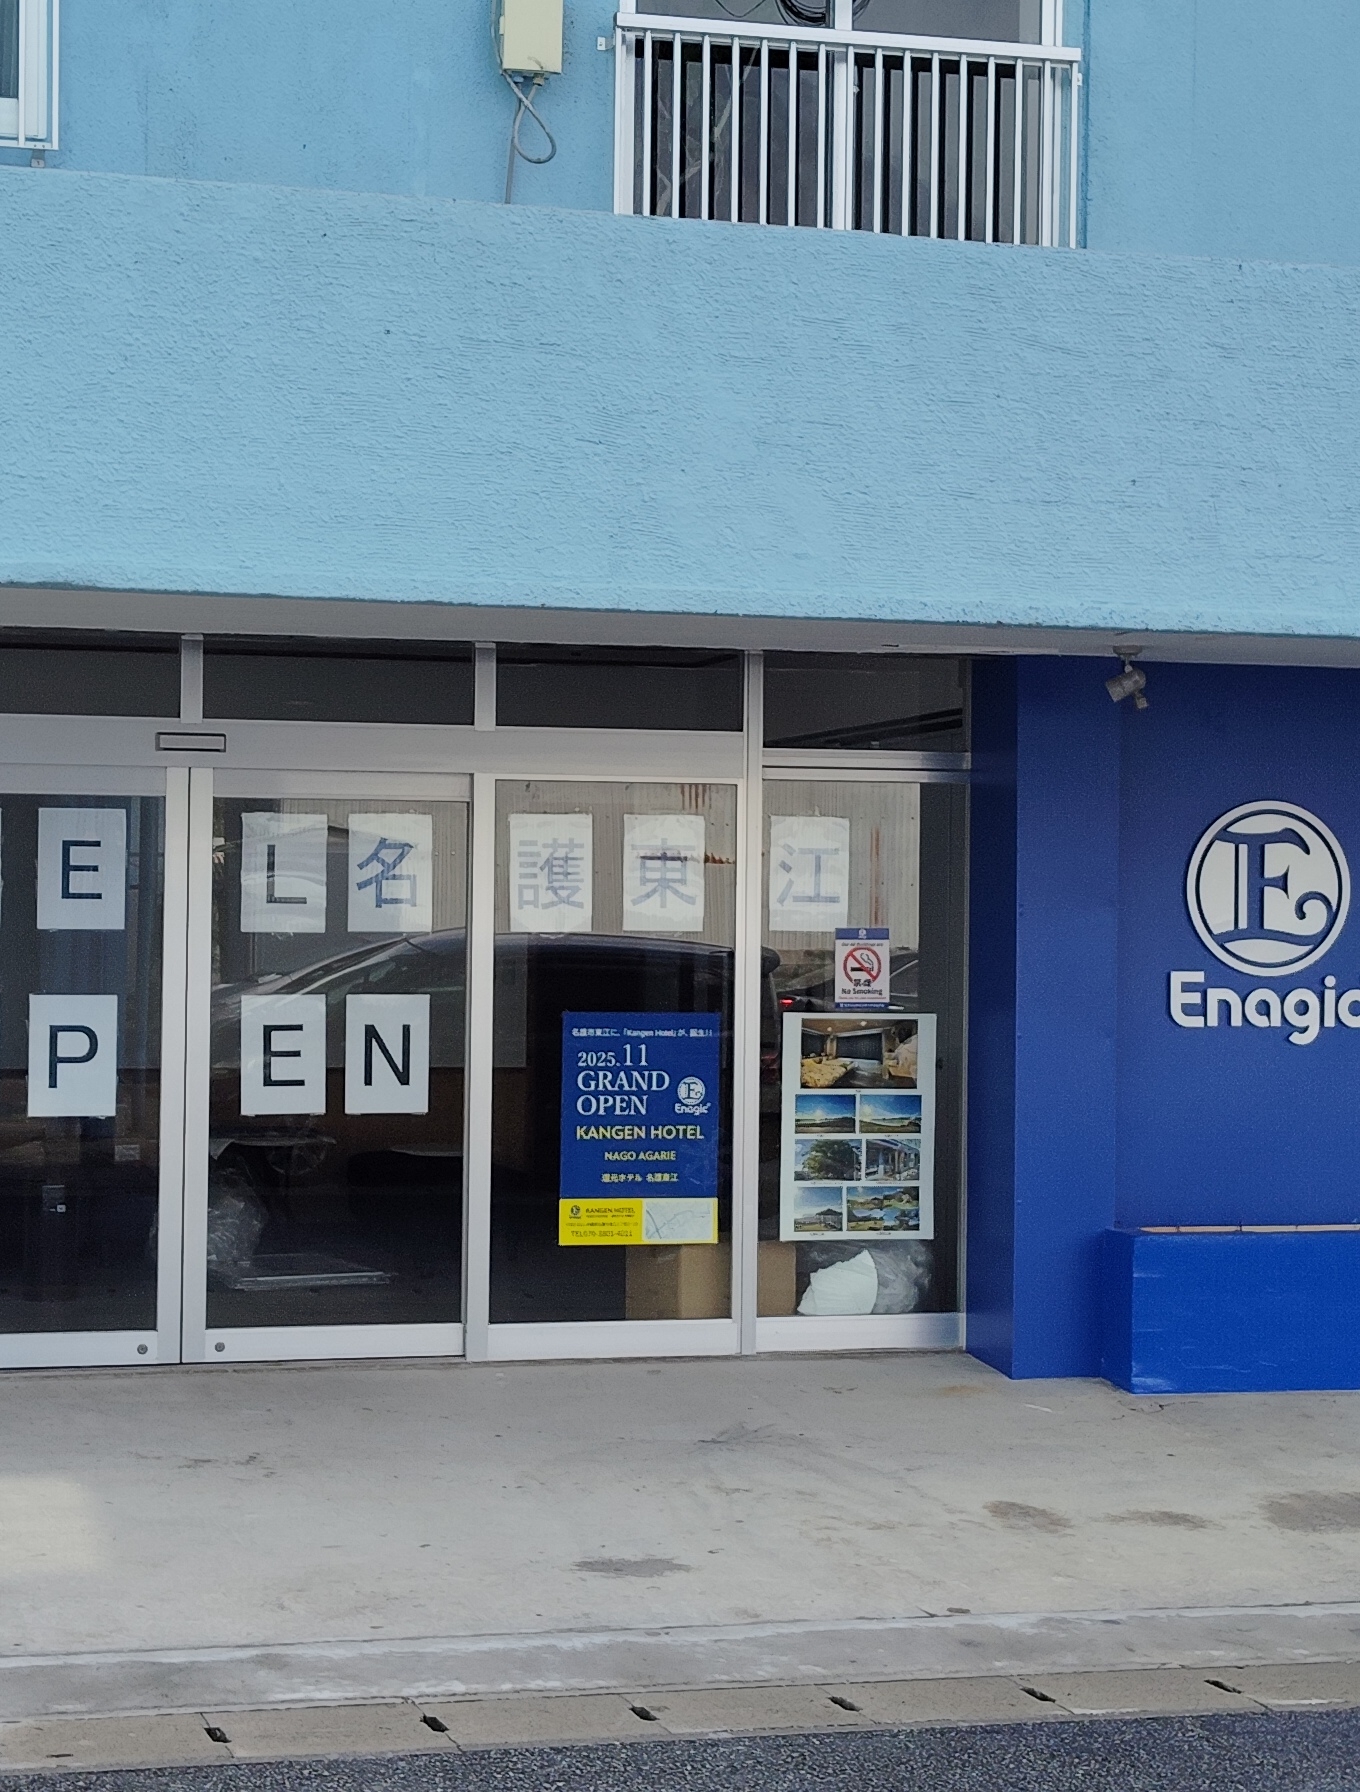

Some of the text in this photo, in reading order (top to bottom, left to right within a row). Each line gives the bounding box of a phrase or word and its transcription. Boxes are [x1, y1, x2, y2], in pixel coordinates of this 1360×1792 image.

[577, 1043, 649, 1067] 2025.11
[576, 1070, 670, 1092] GRAND
[576, 1094, 649, 1116] OPEN
[576, 1124, 705, 1141] KANGEN HOTEL
[604, 1150, 677, 1161] NAGO AGARIE
